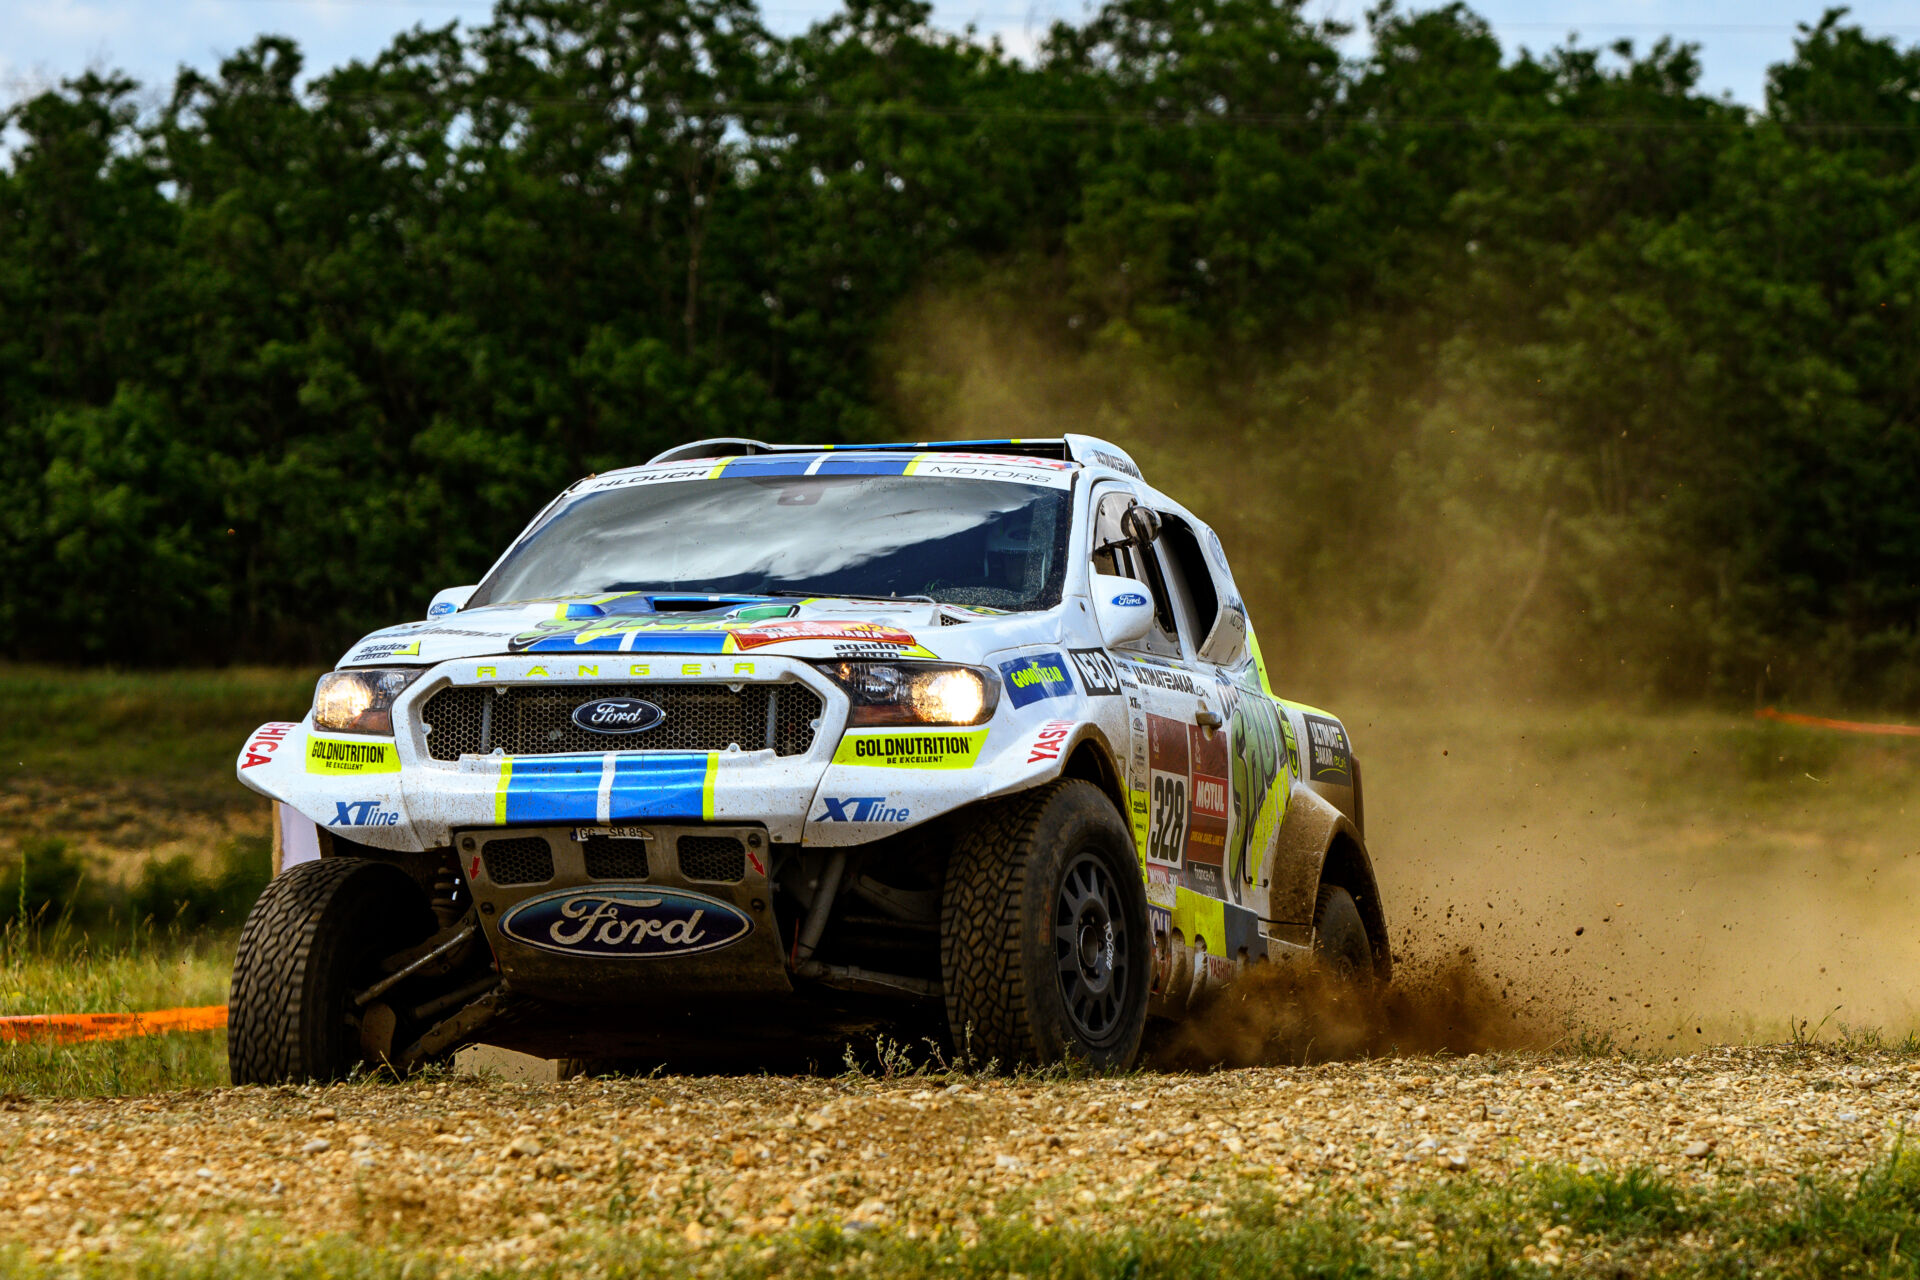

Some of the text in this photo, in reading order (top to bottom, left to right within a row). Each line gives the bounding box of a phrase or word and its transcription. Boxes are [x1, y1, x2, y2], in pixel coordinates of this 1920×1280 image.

[929, 466, 1051, 483] MOTORS
[1118, 594, 1142, 607] Ford
[833, 641, 909, 652] agados
[476, 662, 756, 678] RANGER
[1011, 662, 1065, 689] GOODYEAR
[1070, 652, 1119, 692] NEXO
[590, 702, 642, 725] Ford
[311, 740, 385, 763] GOLDNUTRITION
[855, 736, 970, 758] GOLDNUTRITION
[333, 762, 364, 771] EXCELLENT
[886, 755, 943, 765] BE EXCELLENT
[1195, 780, 1225, 812] MOTUL
[328, 801, 399, 826] XTline
[814, 797, 910, 823] XTline
[1150, 775, 1185, 863] 328
[550, 895, 705, 945] Ford
